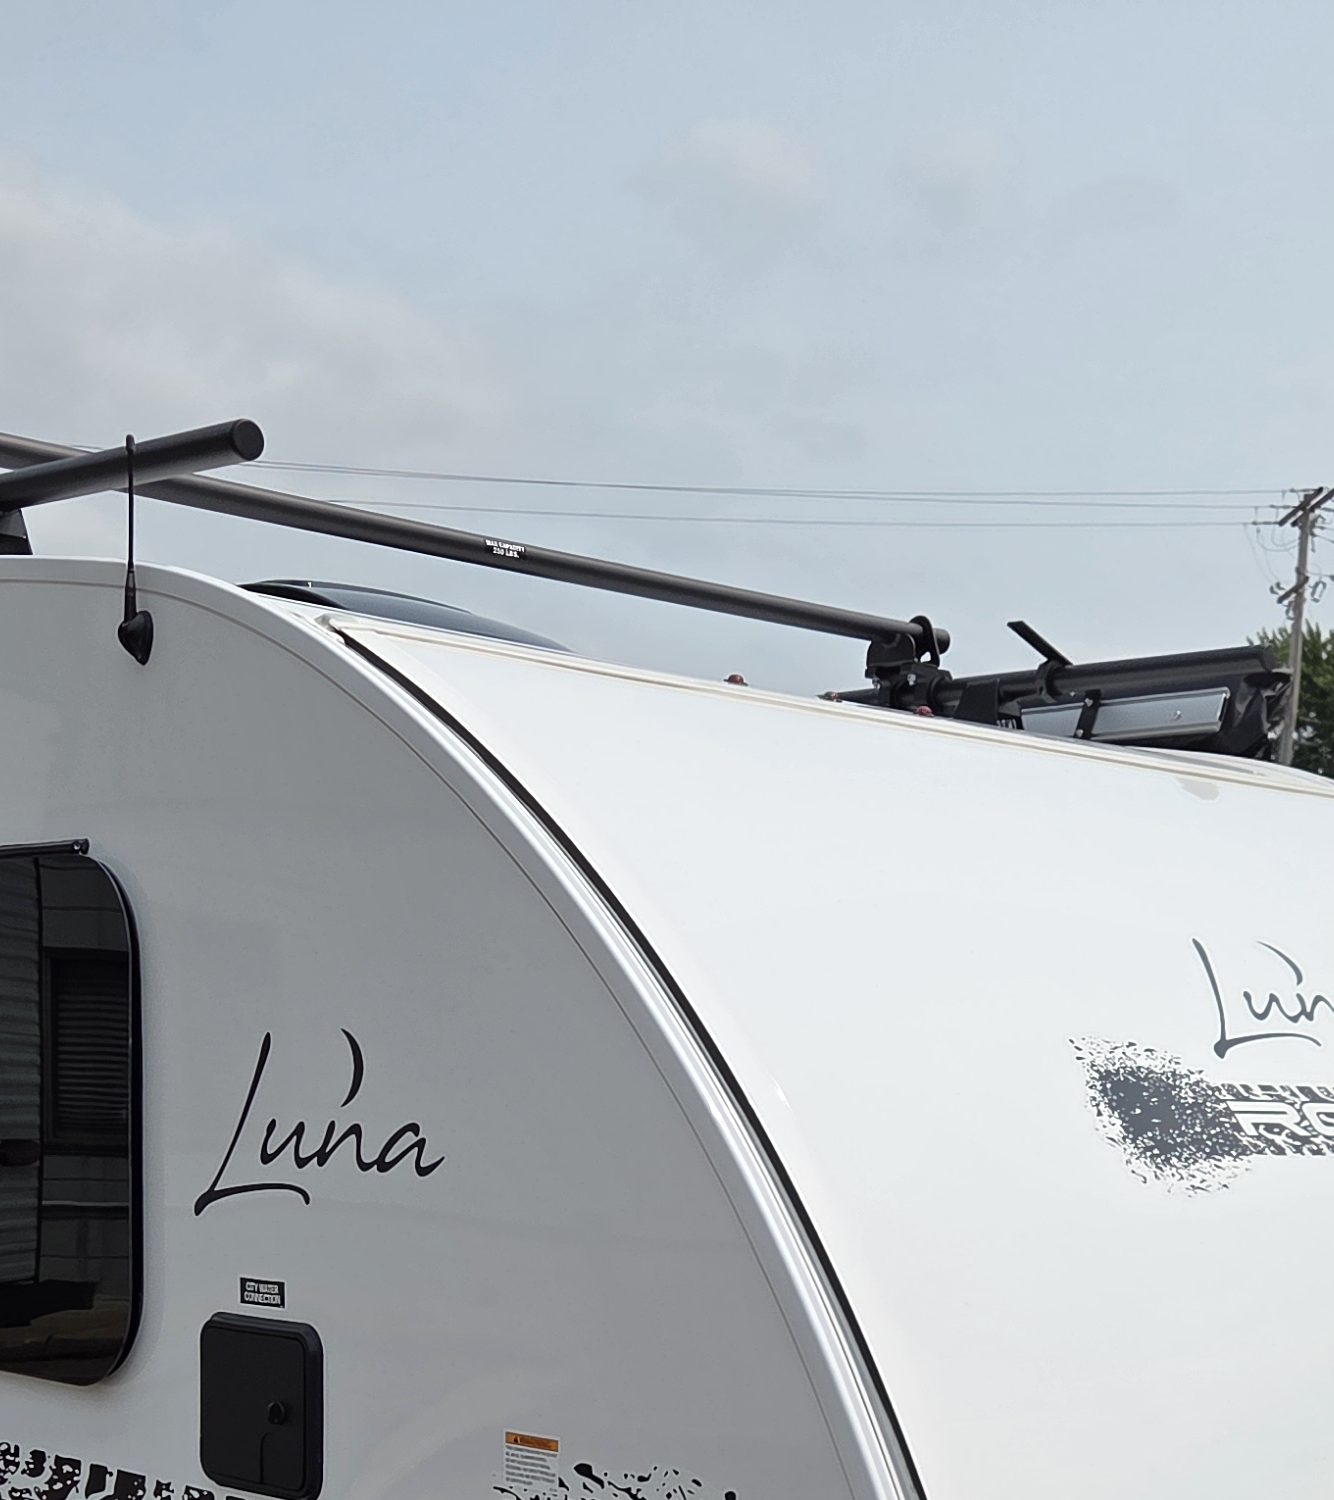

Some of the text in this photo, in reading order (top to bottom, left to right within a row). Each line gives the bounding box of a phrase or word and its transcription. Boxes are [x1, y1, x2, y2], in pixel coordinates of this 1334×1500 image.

[194, 1028, 446, 1216] Luna
[245, 1281, 279, 1294] CITY WATER
[244, 1291, 281, 1305] CONNECTION
